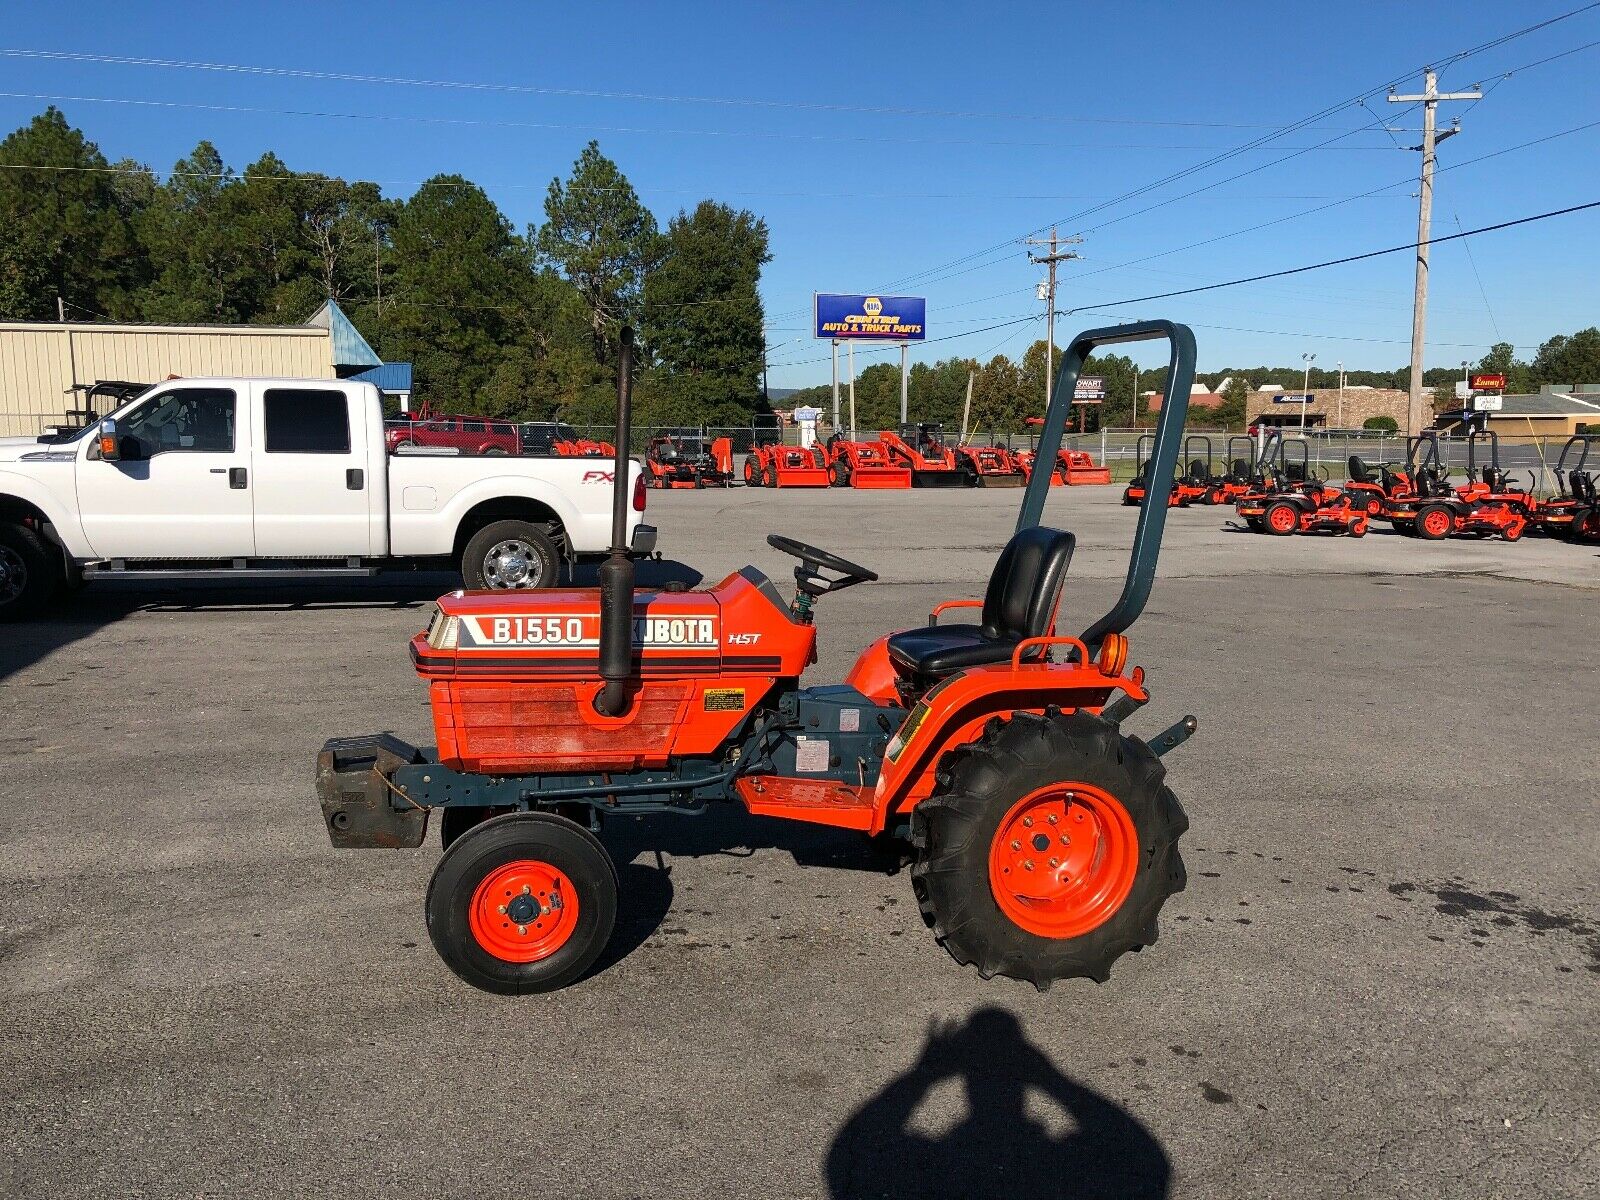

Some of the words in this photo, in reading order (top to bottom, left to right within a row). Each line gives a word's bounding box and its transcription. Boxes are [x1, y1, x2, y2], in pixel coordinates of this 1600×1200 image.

[822, 322, 848, 331] AUTO
[851, 323, 859, 331] &
[861, 323, 890, 332] TRUCK
[893, 325, 921, 333] PARTS
[583, 471, 615, 482] FX
[493, 617, 583, 643] B1550
[728, 633, 762, 644] HST
